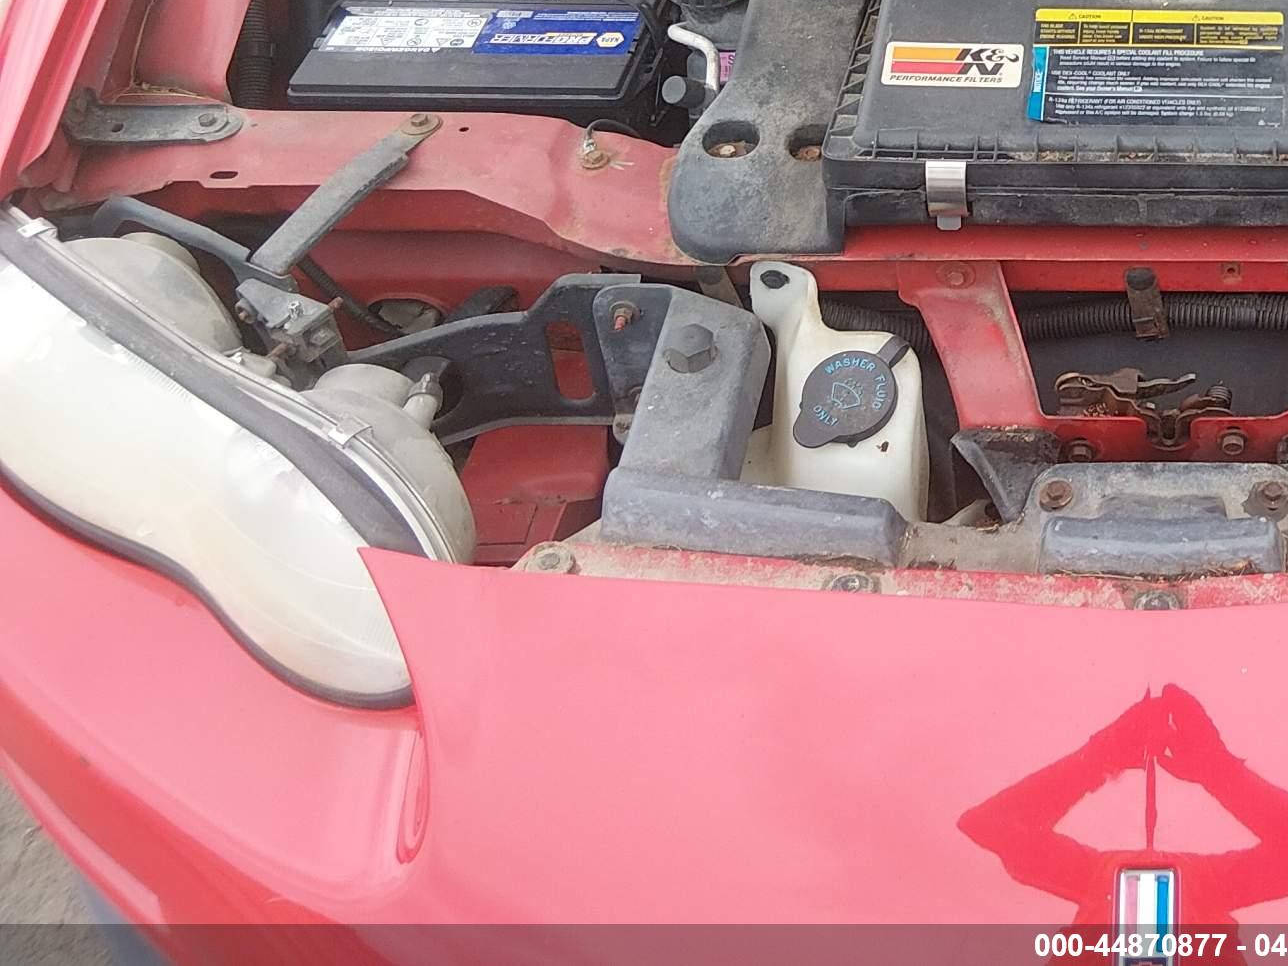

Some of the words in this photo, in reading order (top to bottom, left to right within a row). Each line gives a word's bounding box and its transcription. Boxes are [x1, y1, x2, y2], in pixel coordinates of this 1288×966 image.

[889, 75, 962, 83] PERFORMANCE
[824, 357, 877, 376] WASHER
[871, 374, 888, 410] FLUID
[813, 404, 839, 427] ONLY
